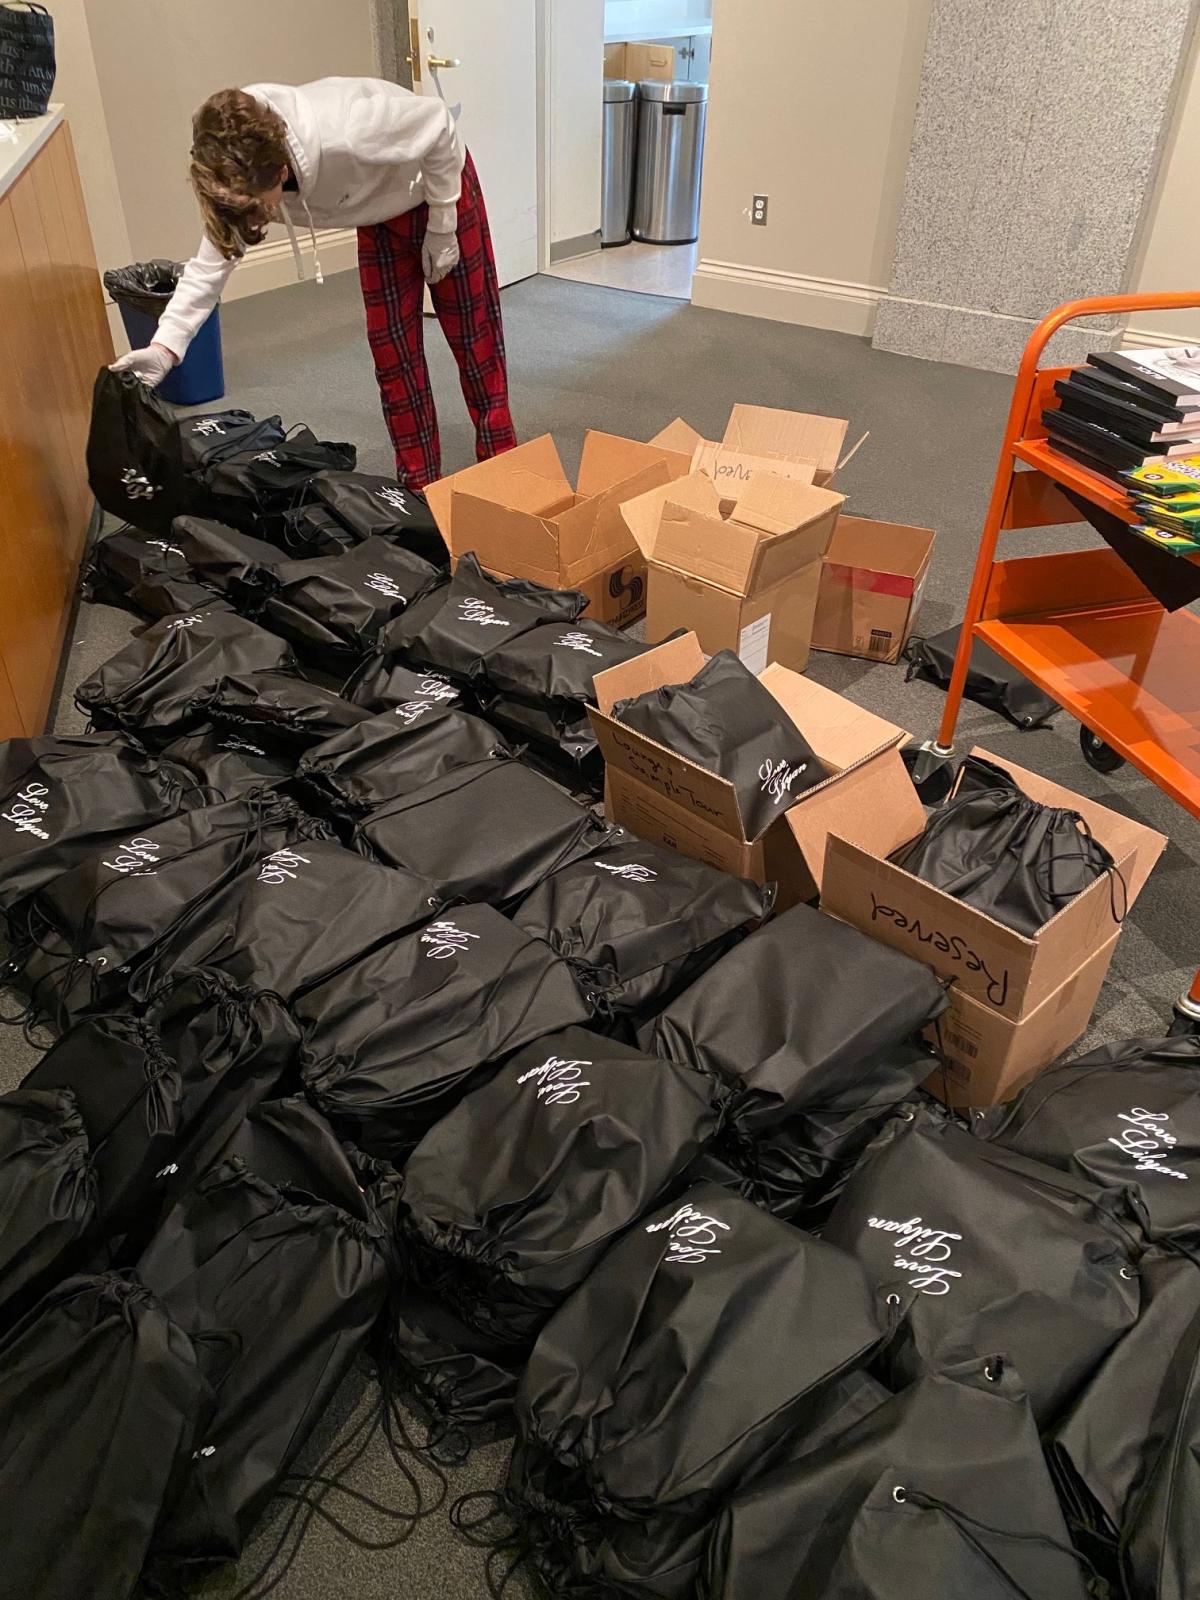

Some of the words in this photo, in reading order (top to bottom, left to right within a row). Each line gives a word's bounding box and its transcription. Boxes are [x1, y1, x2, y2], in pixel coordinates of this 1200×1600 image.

[678, 784, 723, 816] Tour
[1, 804, 50, 840] Lilyan
[871, 892, 1008, 1006] Reserved
[1107, 1129, 1188, 1179] Lilyan
[867, 1217, 963, 1262] Lilyan
[893, 1254, 963, 1296] Love,
